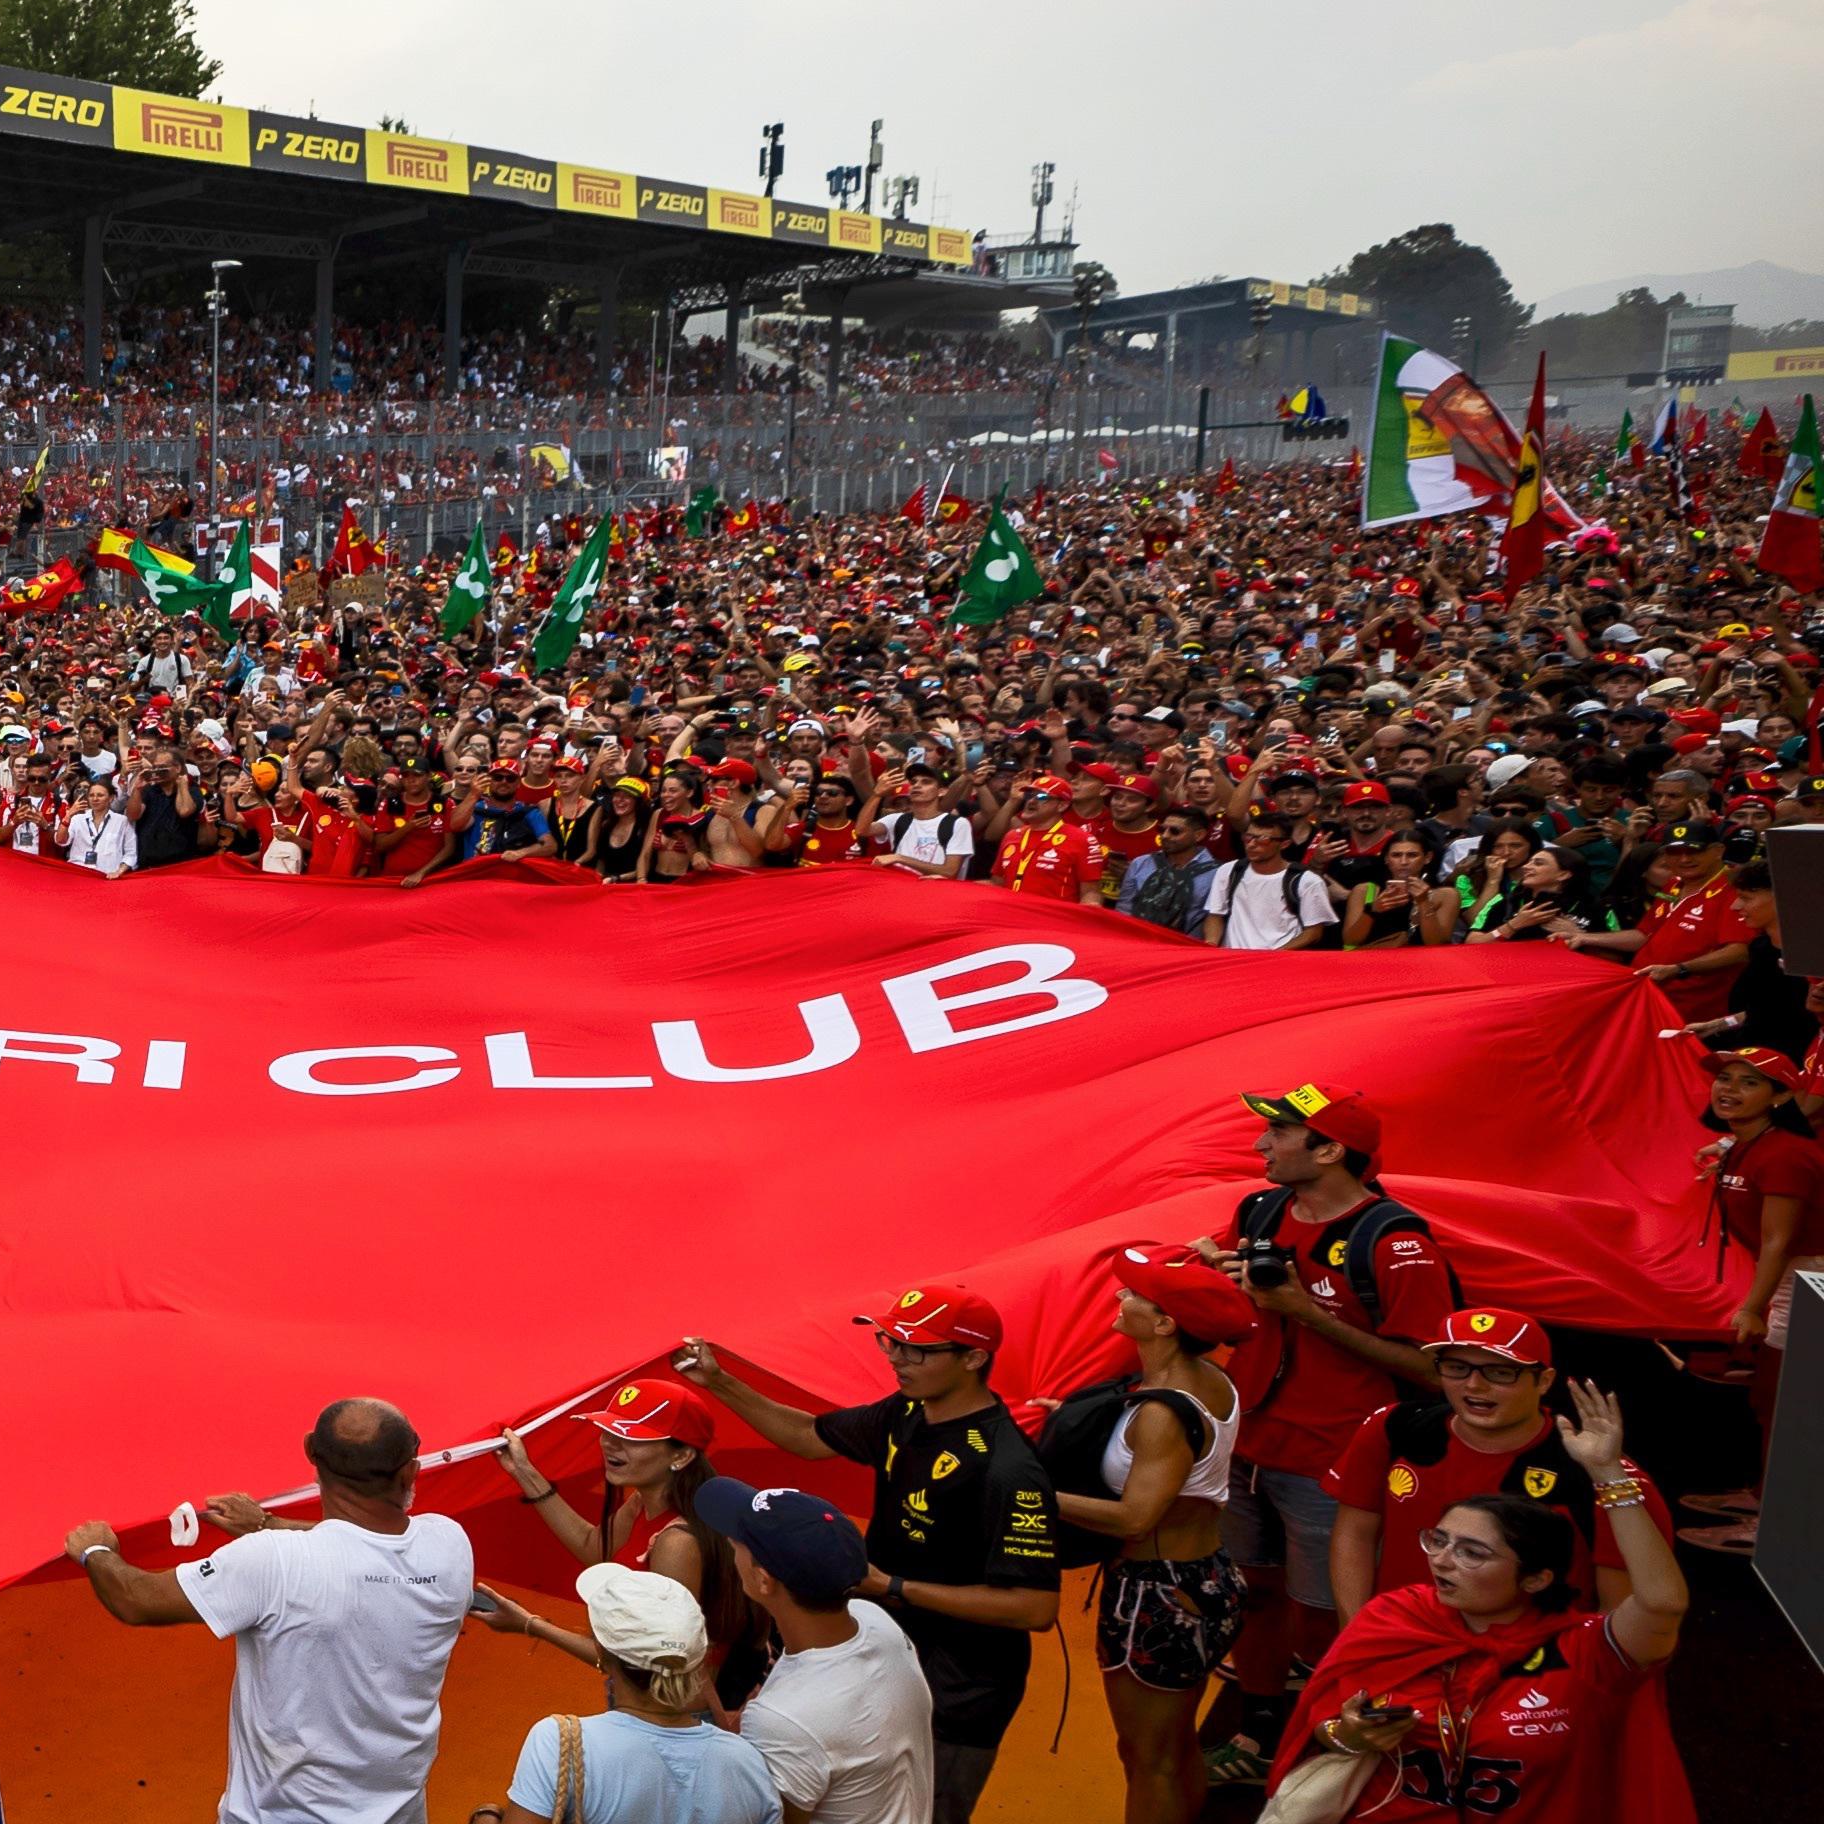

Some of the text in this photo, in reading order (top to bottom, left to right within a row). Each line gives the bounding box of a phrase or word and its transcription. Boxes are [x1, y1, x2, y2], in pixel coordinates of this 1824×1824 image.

[0, 86, 105, 127] ZERO
[142, 103, 223, 152] PIRELLI
[256, 128, 359, 164] P ZERO
[386, 141, 448, 183] PIRELLI
[473, 162, 551, 193] P ZERO
[573, 172, 621, 209] PIRELLI
[640, 189, 704, 216] P ZERO
[720, 195, 759, 228] PIRELLI
[774, 211, 826, 235] P ZERO
[267, 943, 1109, 1097] CLUB
[1392, 1239, 1421, 1251] aws
[1016, 1491, 1042, 1502] aws
[364, 1575, 391, 1585] MAKE
[1501, 1707, 1570, 1722] Santander
